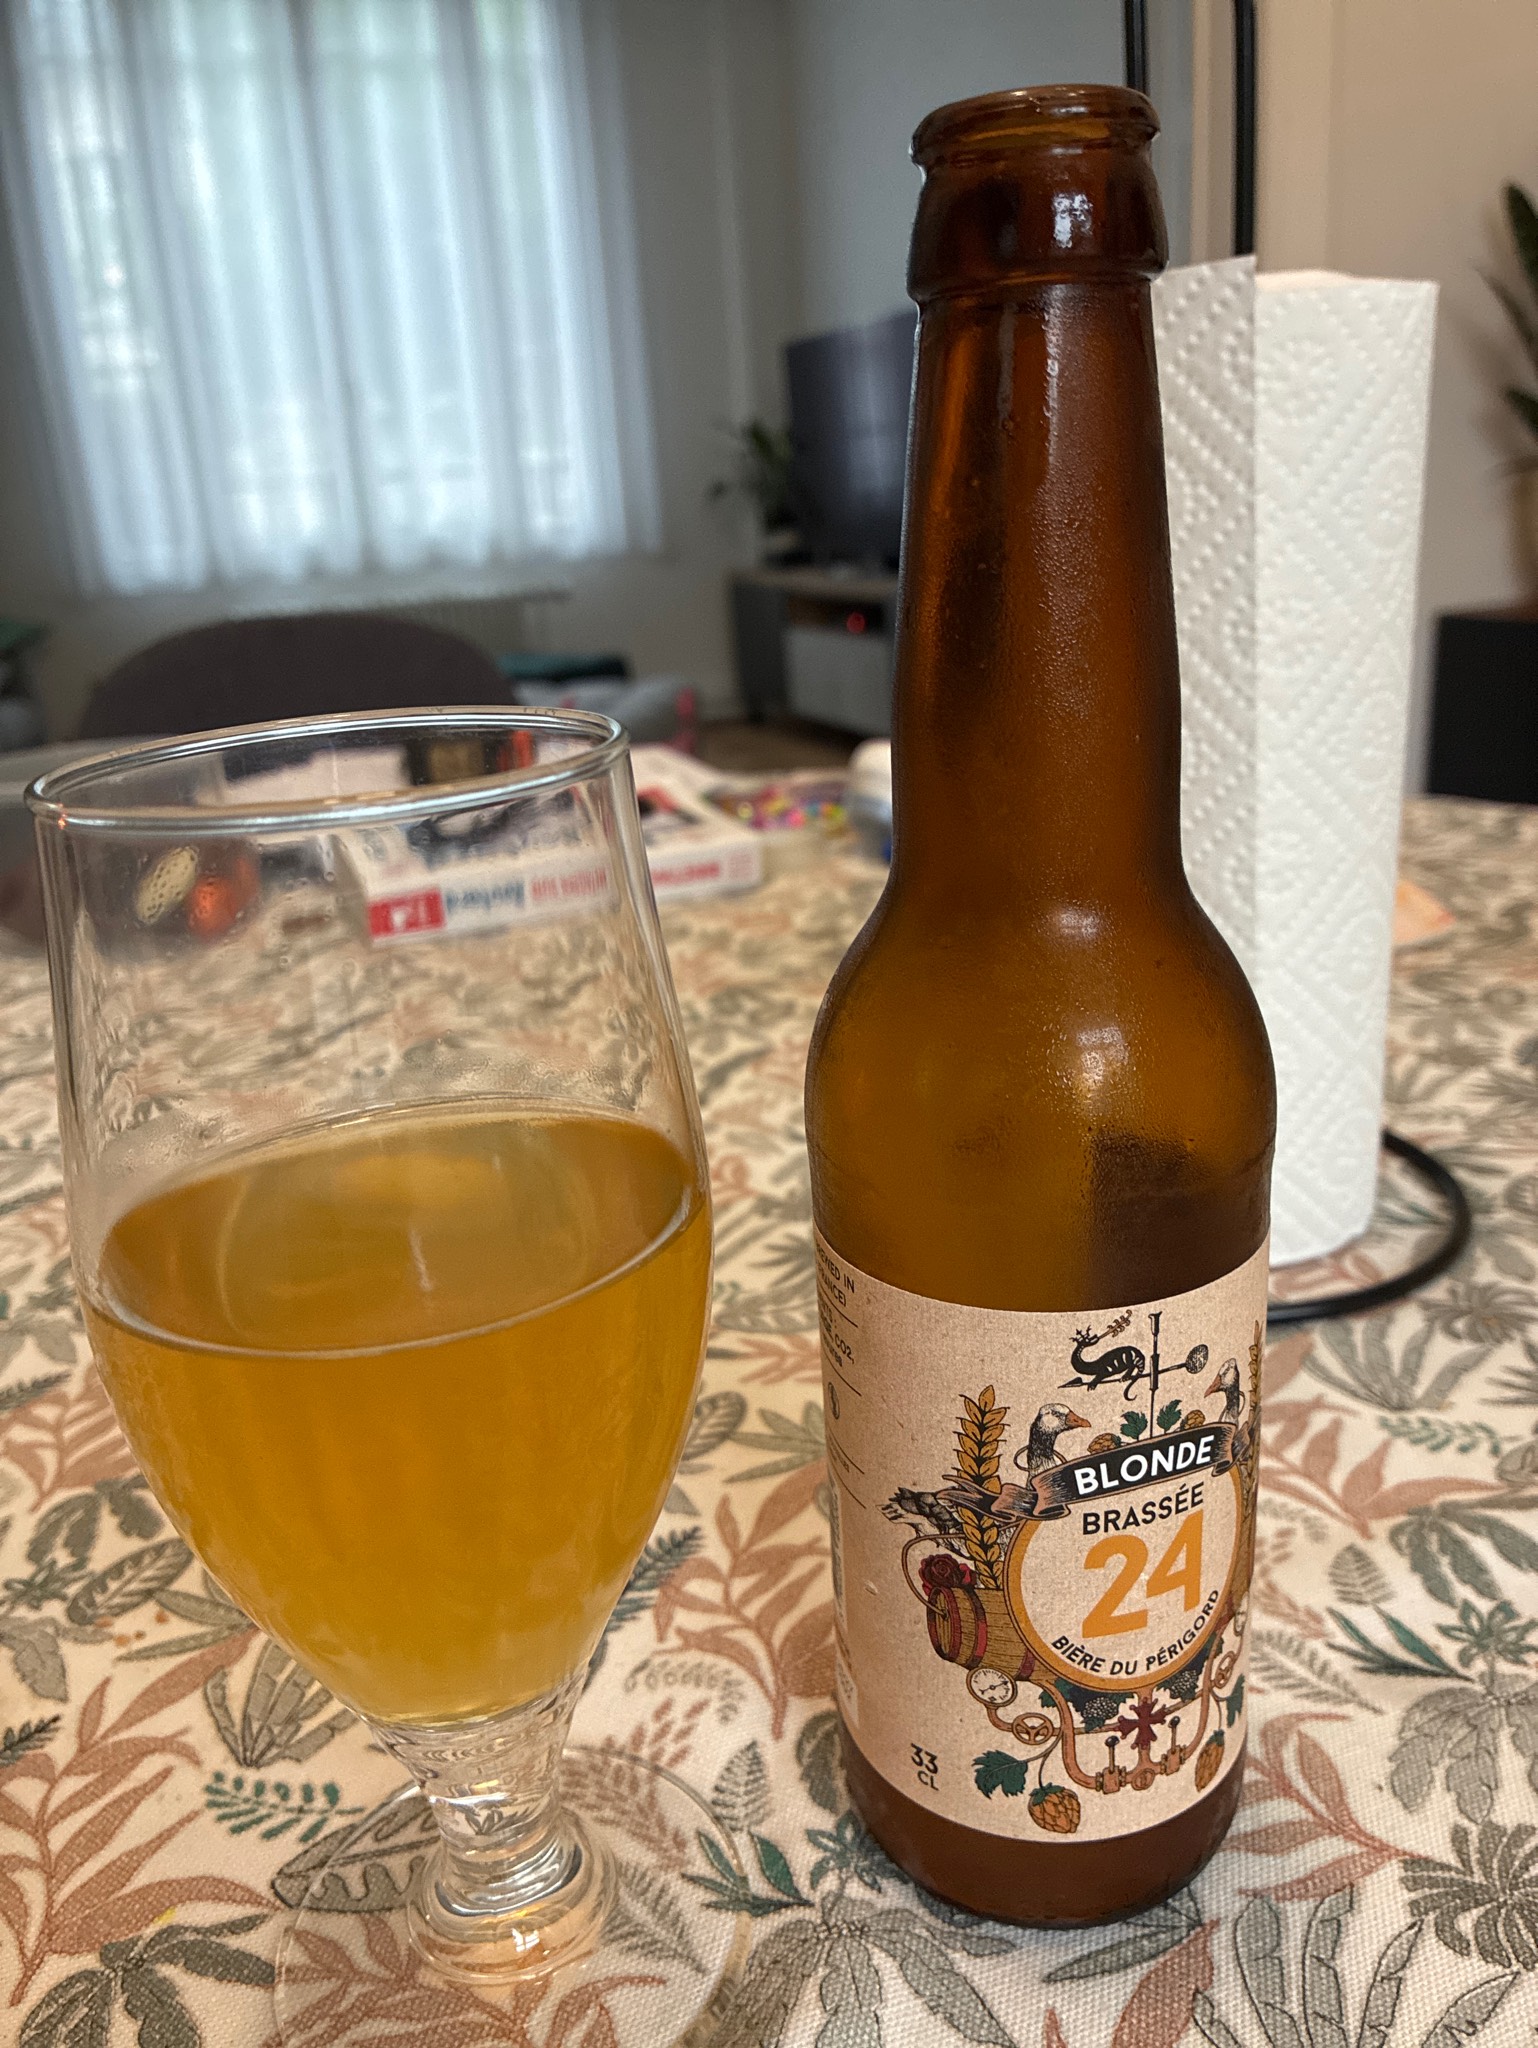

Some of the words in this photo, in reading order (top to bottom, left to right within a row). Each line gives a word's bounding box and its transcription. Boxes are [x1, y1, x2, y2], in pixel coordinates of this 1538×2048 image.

[843, 1273, 855, 1294] IN
[1073, 1434, 1215, 1495] BLONDE
[1082, 1481, 1205, 1535] BRASSÉE
[1081, 1508, 1204, 1639] 24
[1051, 1635, 1106, 1673] BIÈRE
[1109, 1660, 1138, 1676] DU
[1146, 1590, 1219, 1671] PÉRIGORD
[910, 1742, 939, 1774] 33
[917, 1770, 940, 1792] CL
